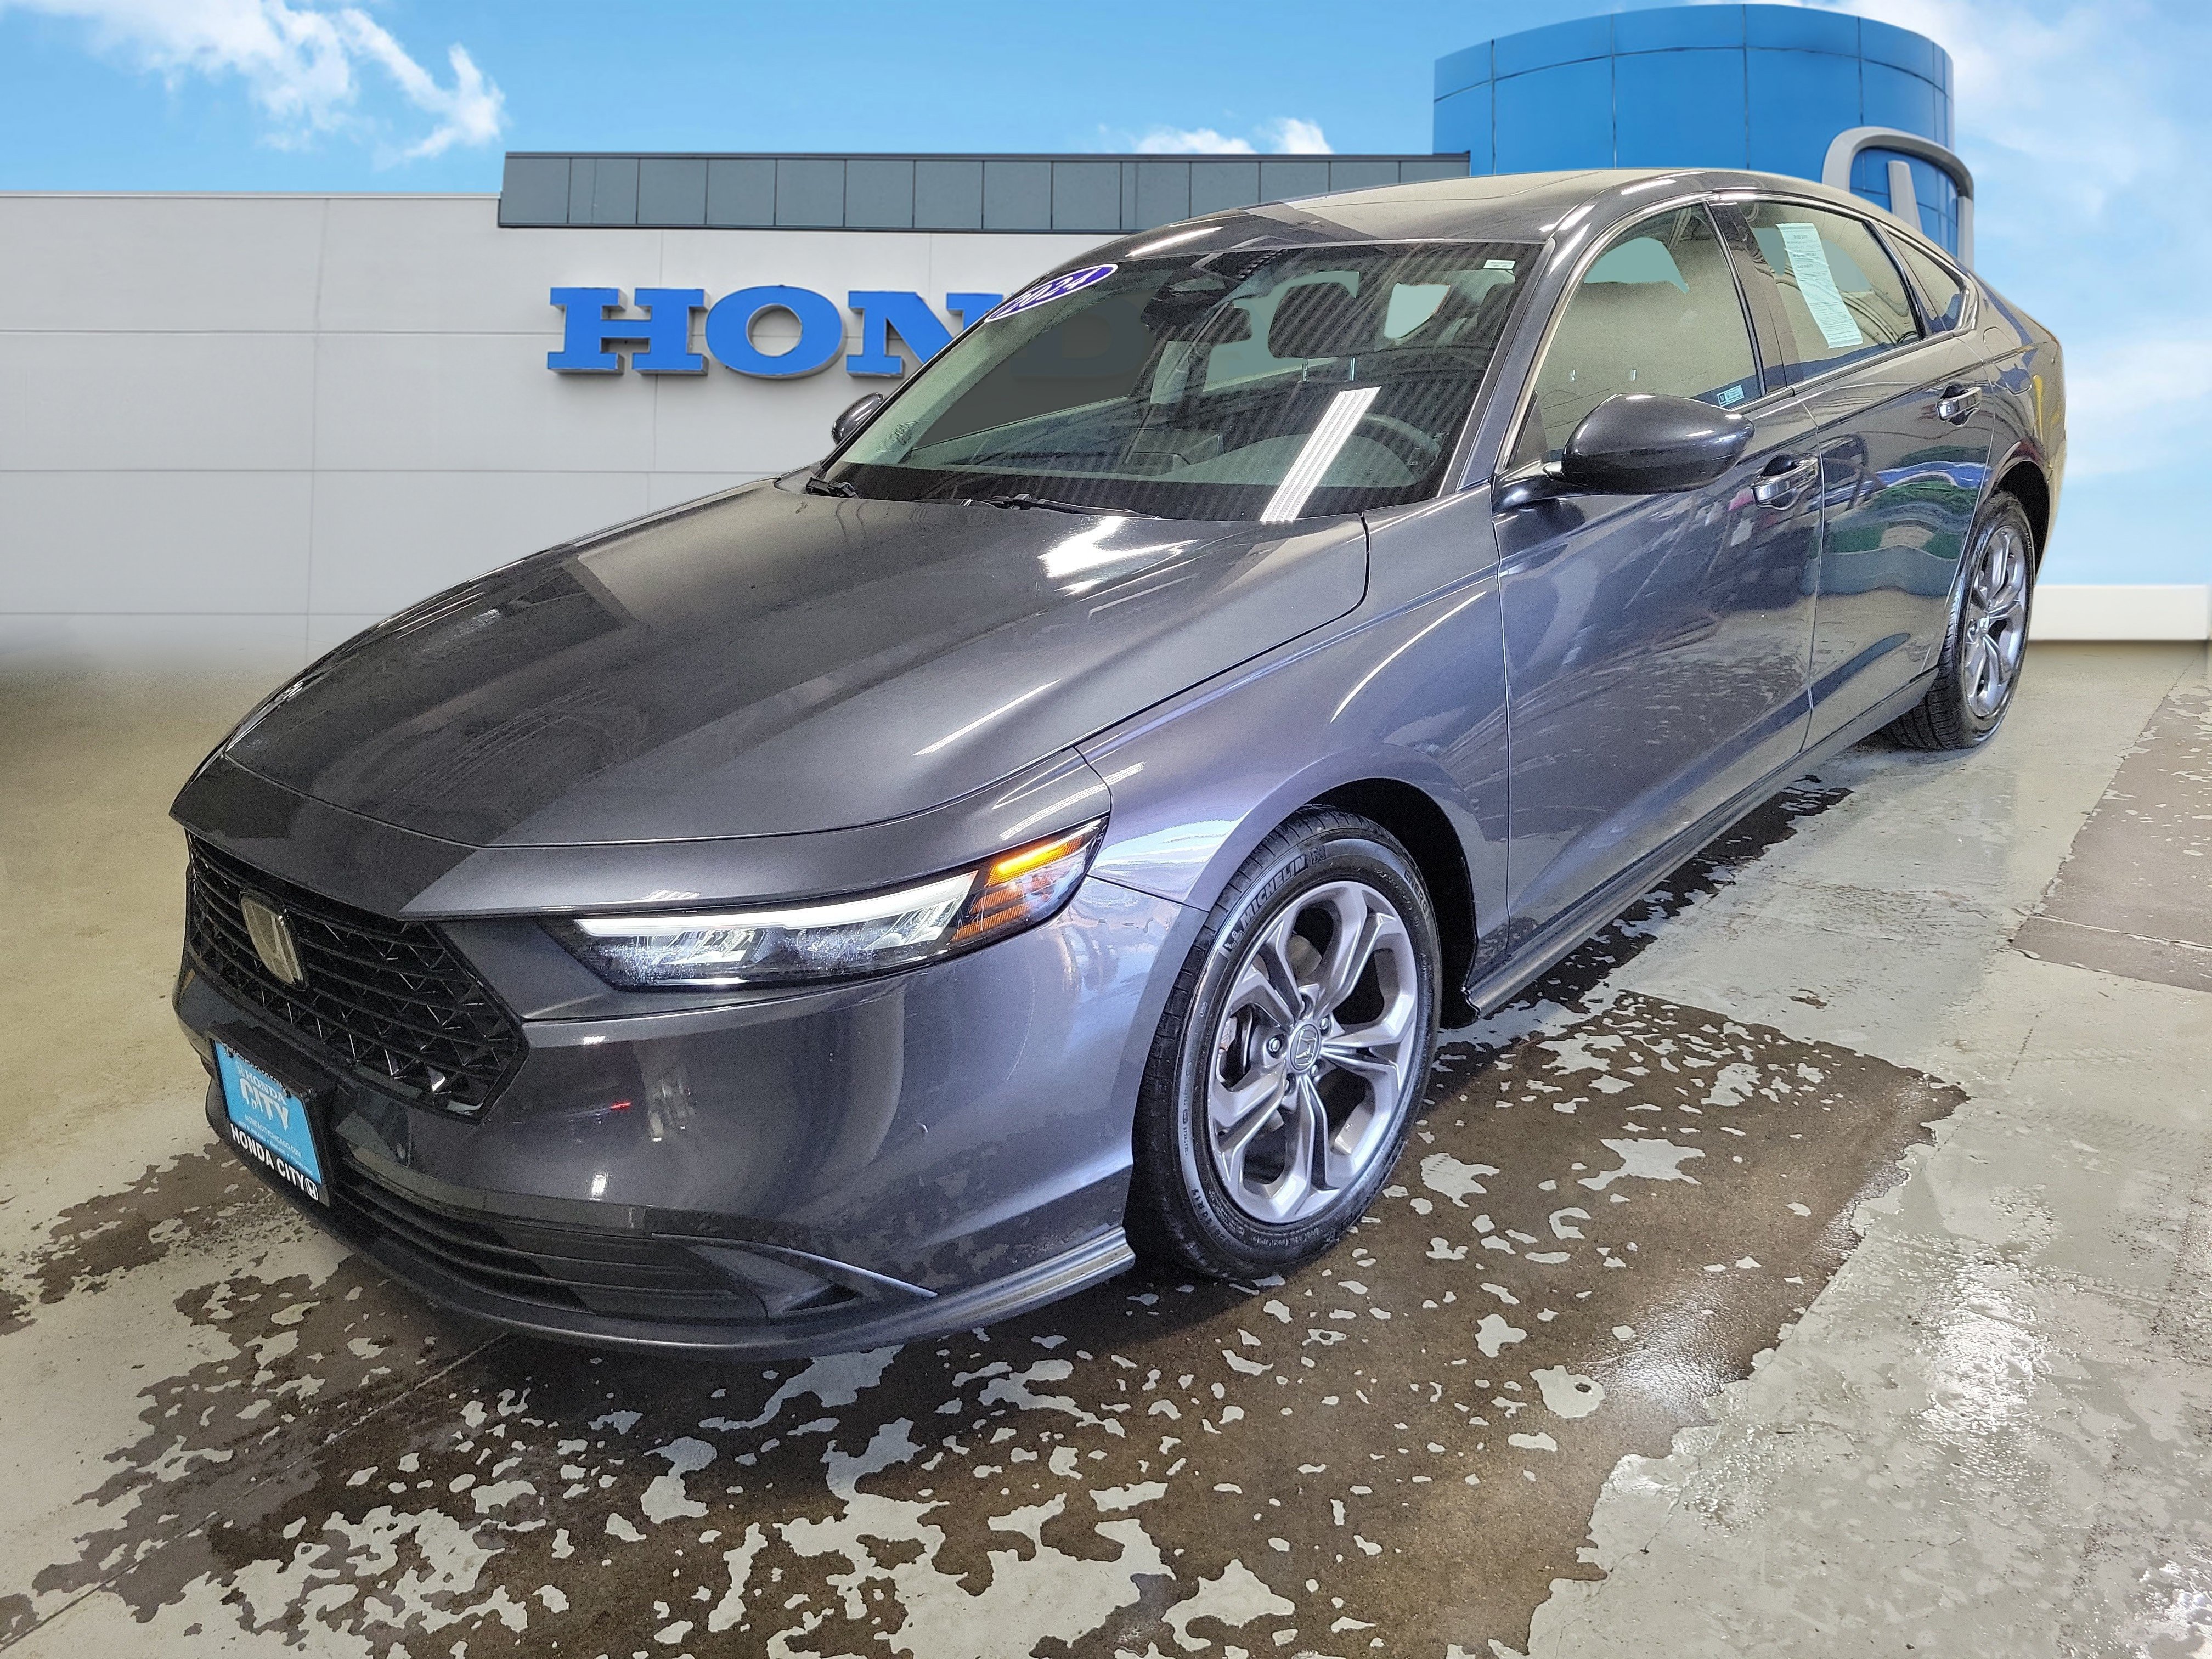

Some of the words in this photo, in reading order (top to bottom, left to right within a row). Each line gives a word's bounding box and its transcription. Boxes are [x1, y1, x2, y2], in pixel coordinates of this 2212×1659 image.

[547, 285, 1005, 377] HON
[1240, 854, 1306, 929] MICHELIN
[246, 1070, 287, 1105] HONDA
[230, 1122, 275, 1170] HONDA
[276, 1158, 304, 1192] CITY
